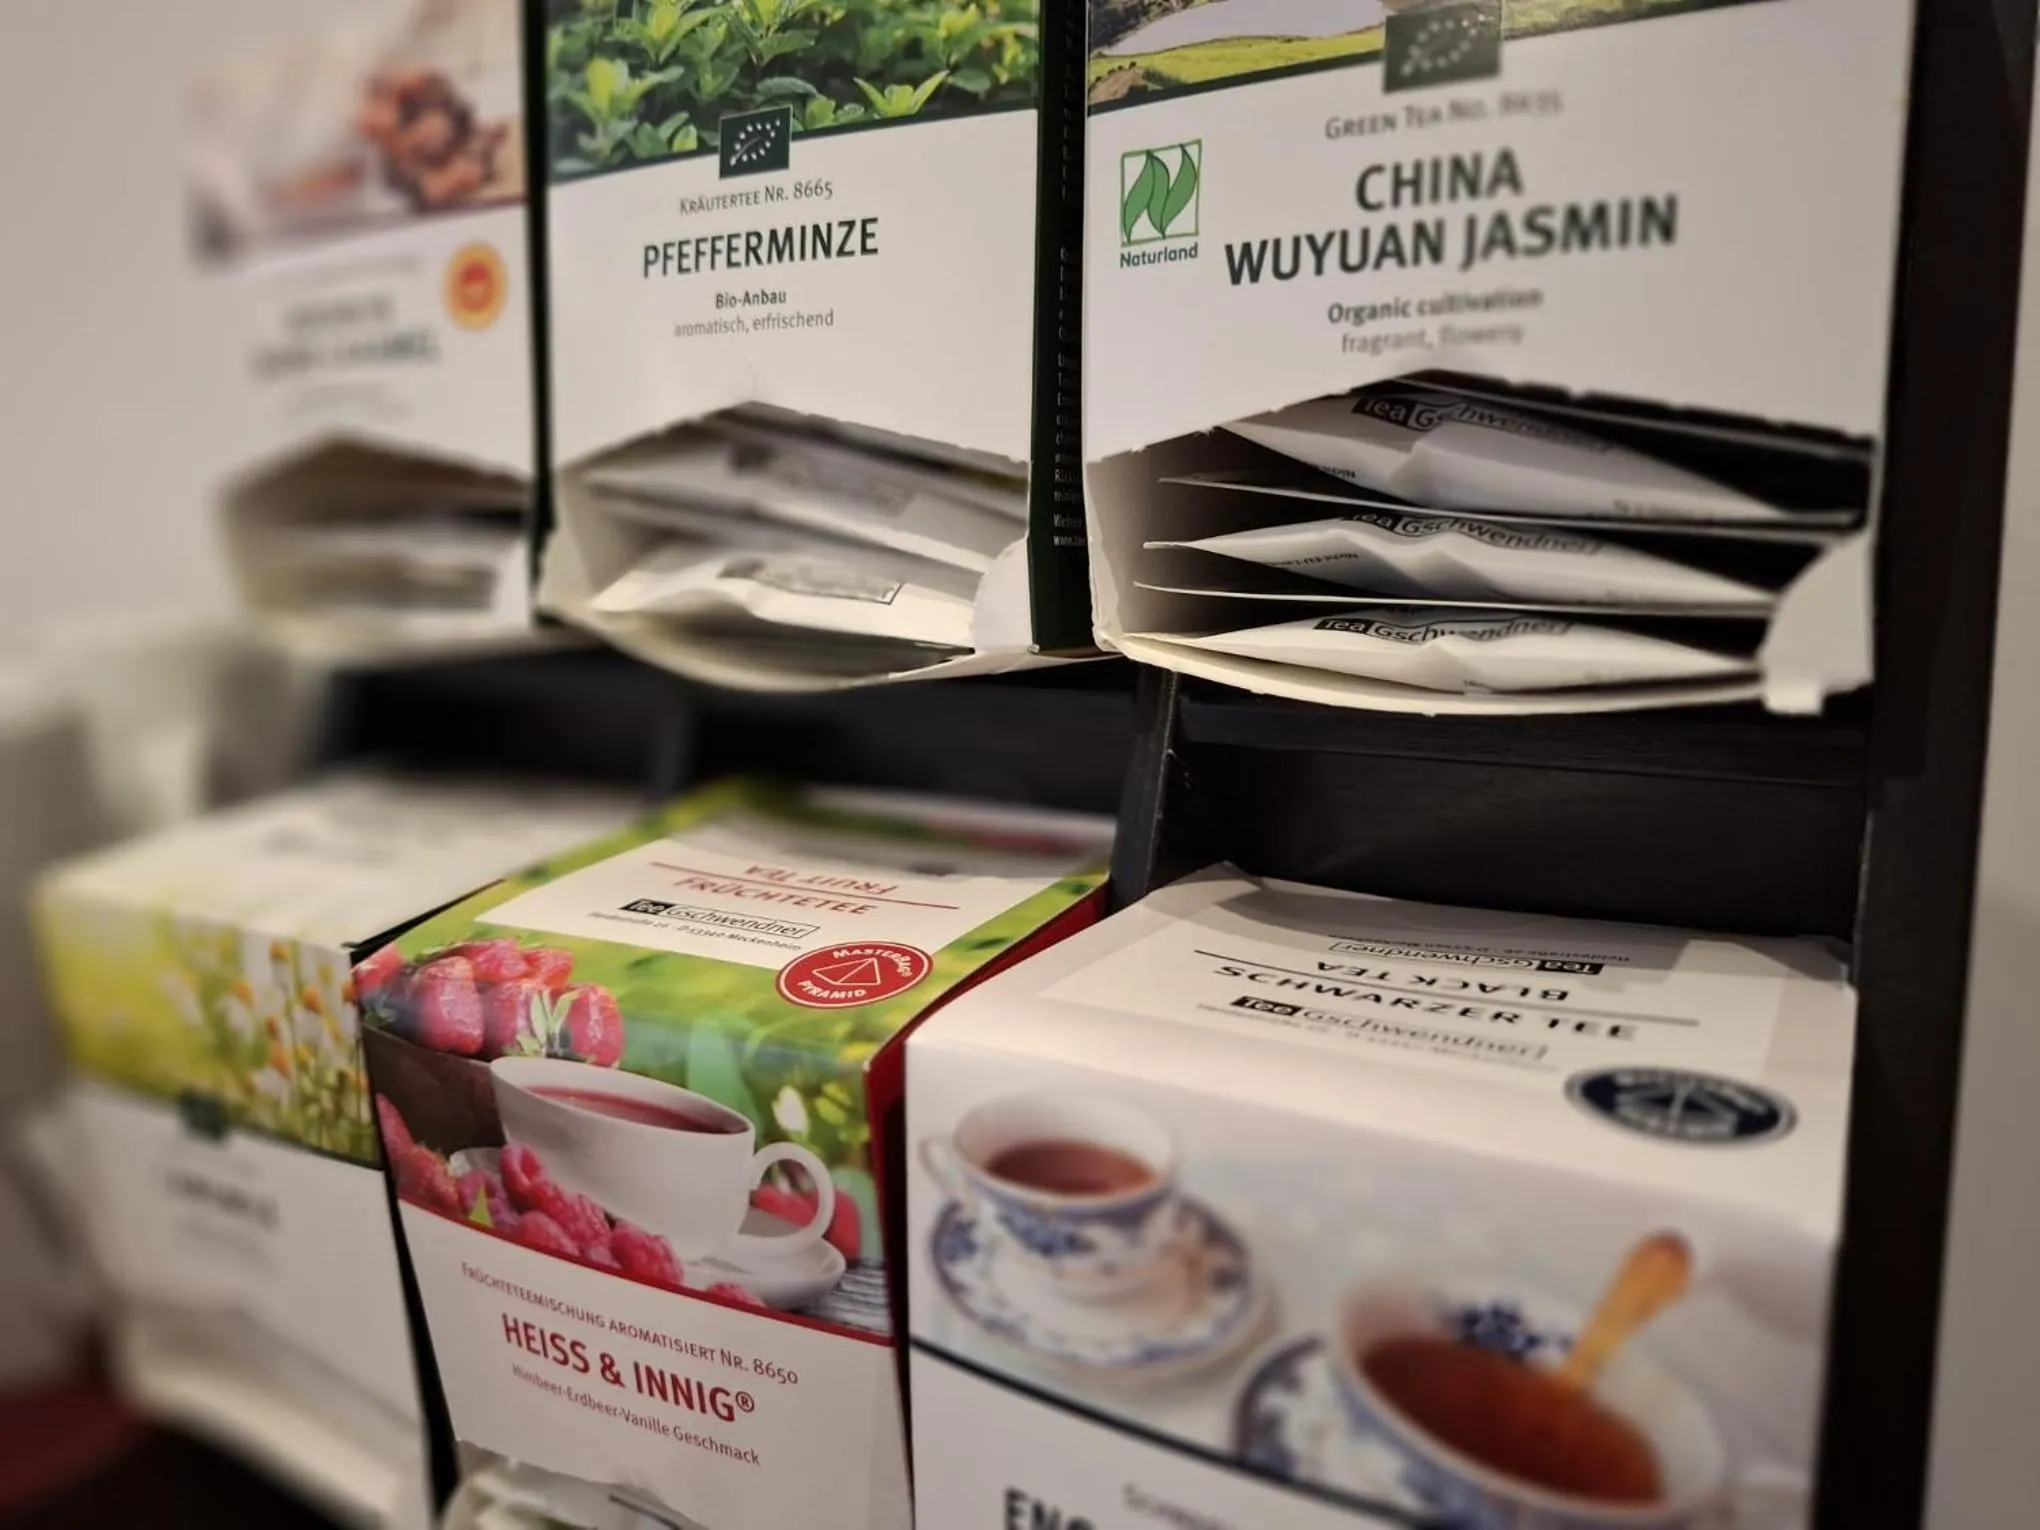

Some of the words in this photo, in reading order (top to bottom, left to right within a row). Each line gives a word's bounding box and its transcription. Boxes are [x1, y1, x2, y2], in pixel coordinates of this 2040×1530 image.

[794, 180, 834, 200] 8665
[1356, 148, 1524, 213] CHINA
[644, 217, 879, 279] PFEFFERMINZE
[1225, 216, 1446, 287] WUYUAN
[1459, 193, 1679, 272] JASMIN
[1120, 243, 1199, 268] Naturland
[715, 290, 787, 310] Bio-Anbau
[1328, 297, 1411, 326] Organic
[1416, 288, 1544, 317] cultivation
[674, 317, 749, 337] aromatisch,
[752, 309, 834, 332] erfrischend
[1342, 329, 1434, 355] fragrant,
[1364, 398, 1405, 421] Tea
[1324, 619, 1365, 633] Tea
[673, 876, 879, 915] FRÜCHTETEE
[666, 905, 807, 936] Gschwendner
[1337, 940, 1533, 969] Gschwendner
[1544, 961, 1596, 974] Tea
[1318, 961, 1391, 982] TEA
[797, 979, 867, 999] PYRAMID
[1408, 974, 1569, 1001] BLACK
[1213, 965, 1522, 1025] SCHWARZER
[1546, 1016, 1637, 1041] TEE
[462, 1262, 606, 1329] FRÜCHTETEEMISCHUNG
[609, 1318, 716, 1362] AROMATISIERT
[720, 1348, 749, 1371] NR.
[753, 1357, 799, 1385] 8650
[502, 1312, 590, 1374] HEISS
[599, 1352, 626, 1388] &
[512, 1362, 669, 1437] Himbeer-Erdbeer-Vanille
[672, 1425, 760, 1467] Geschmack
